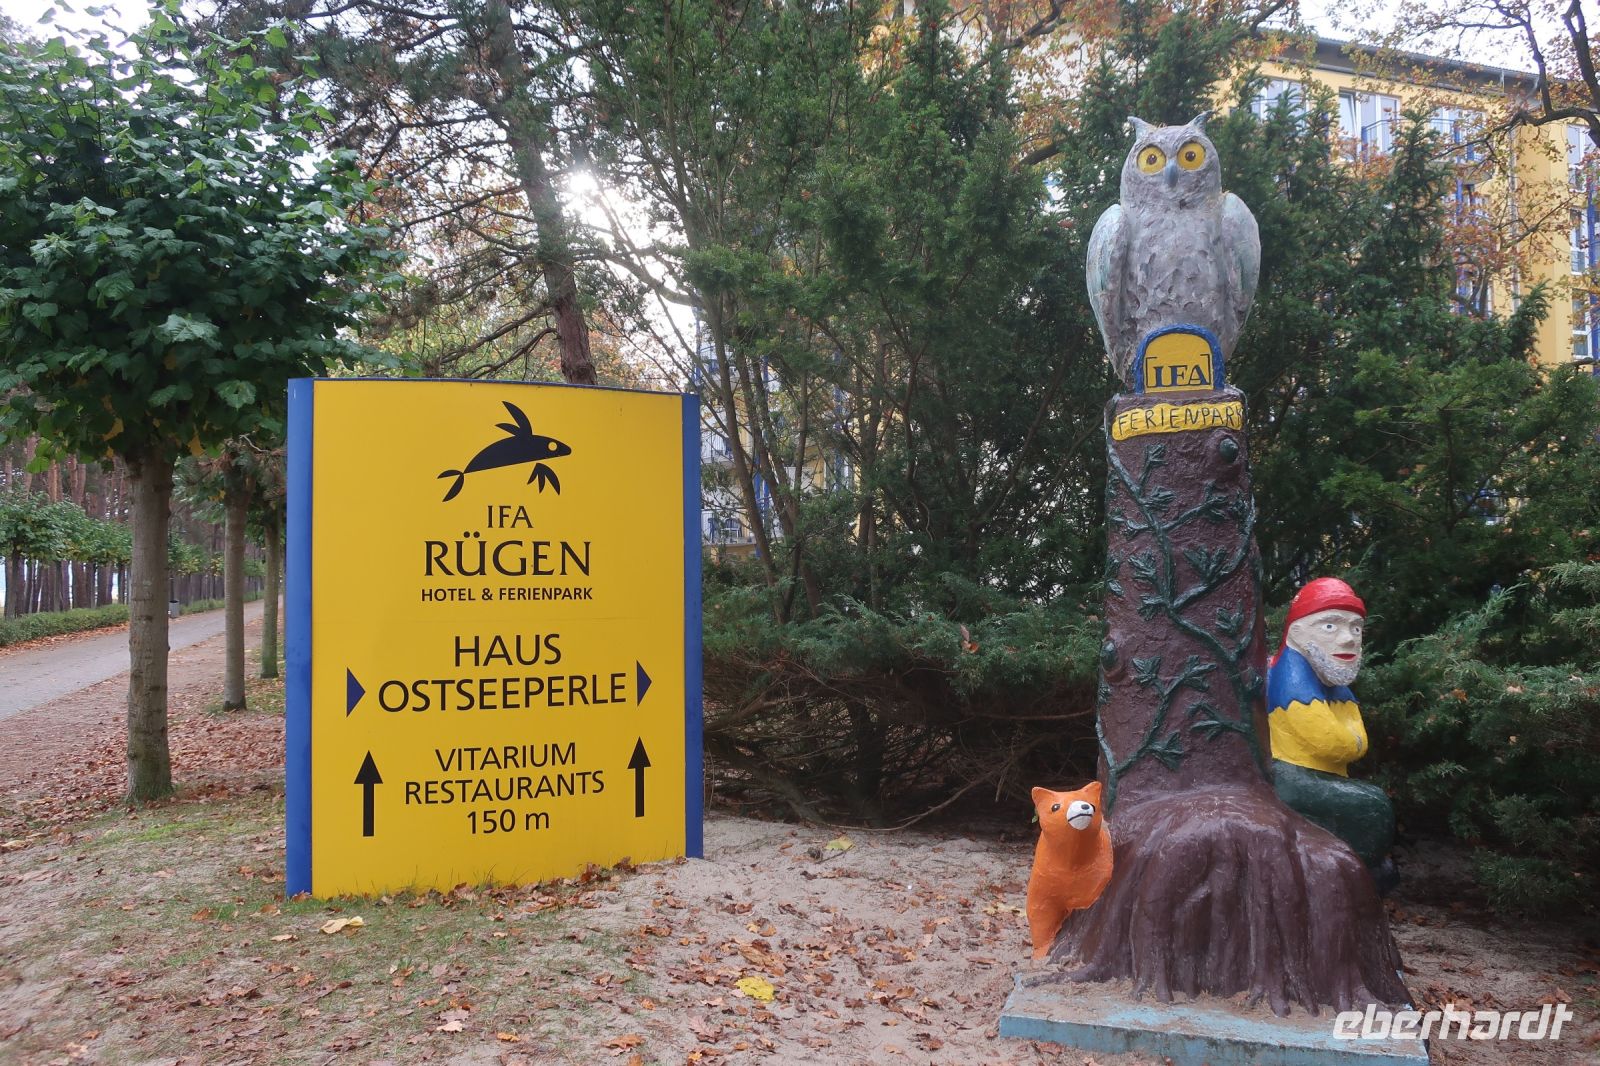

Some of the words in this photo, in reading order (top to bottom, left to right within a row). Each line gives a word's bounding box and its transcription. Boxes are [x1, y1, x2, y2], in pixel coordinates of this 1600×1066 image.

[1153, 364, 1209, 388] IFA
[486, 505, 534, 529] IFA
[424, 530, 592, 577] RÜGEN
[421, 588, 476, 602] HOTEL
[481, 587, 494, 601] &
[499, 587, 593, 601] FERIENPARK
[454, 633, 562, 667] HAUS
[378, 672, 627, 713] OSTSEEPERLE
[435, 742, 576, 772] VITARIUM
[405, 770, 605, 805] RESTAURANTS
[467, 808, 516, 834] 150
[525, 810, 550, 831] m
